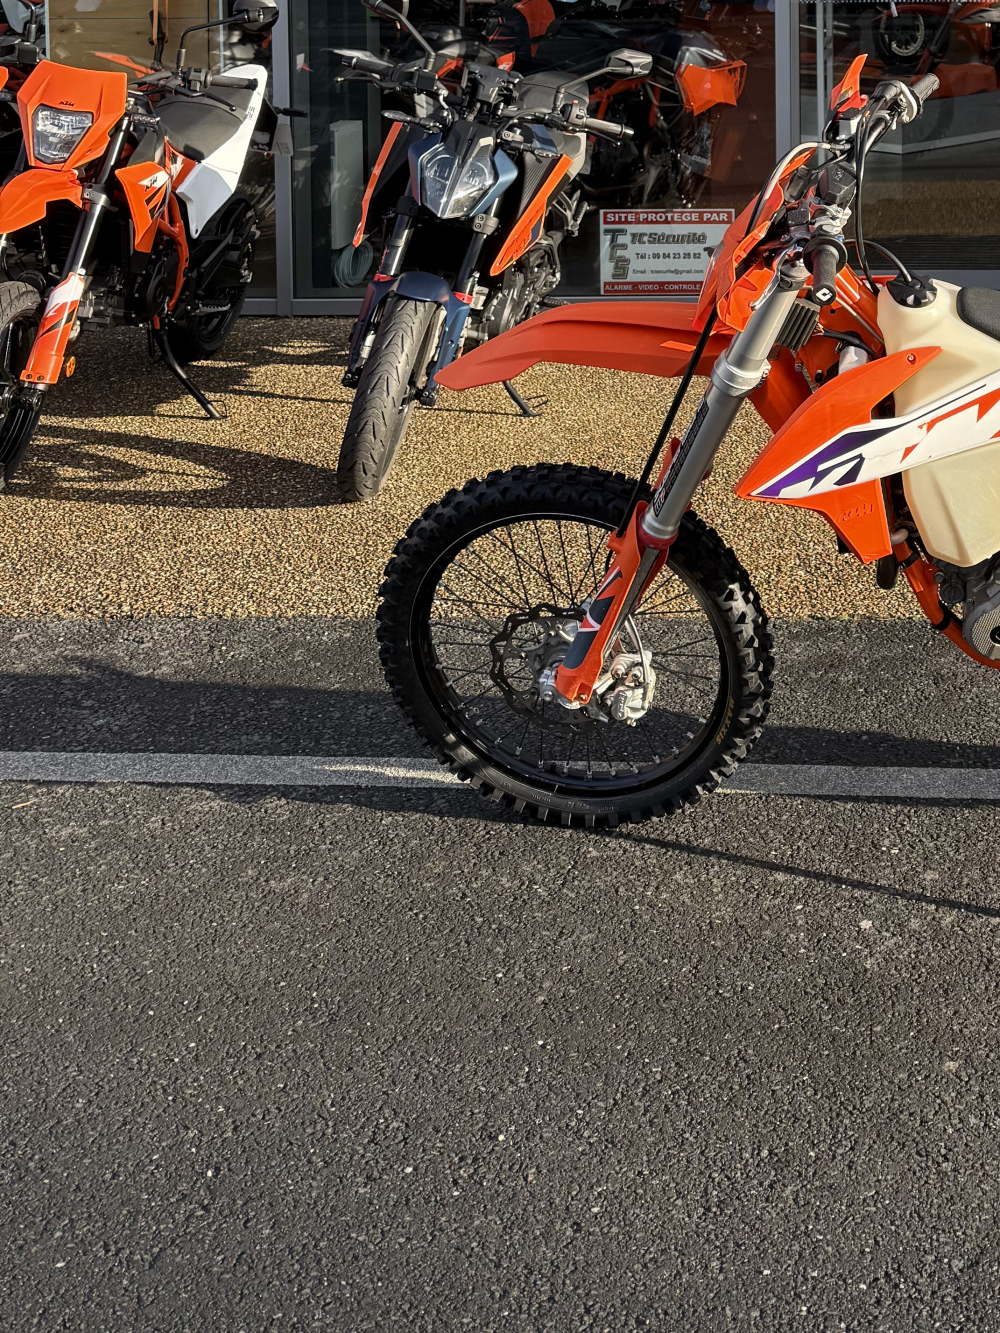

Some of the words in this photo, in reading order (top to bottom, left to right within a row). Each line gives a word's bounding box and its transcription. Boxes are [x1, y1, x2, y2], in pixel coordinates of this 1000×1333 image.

[607, 213, 635, 221] SITE
[640, 213, 699, 221] PROTEGE
[704, 213, 727, 221] PAR
